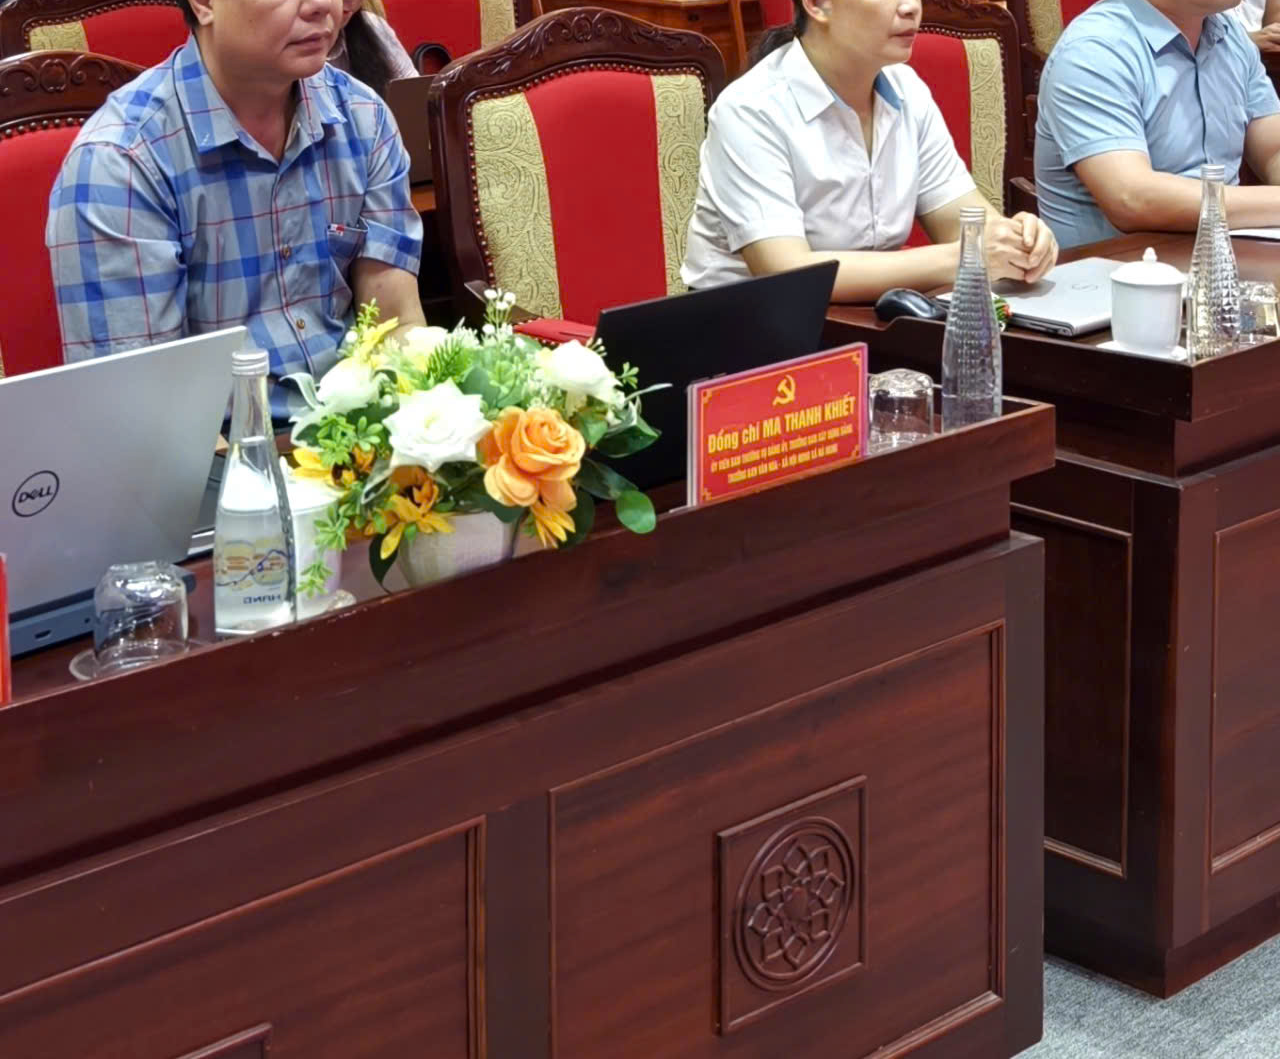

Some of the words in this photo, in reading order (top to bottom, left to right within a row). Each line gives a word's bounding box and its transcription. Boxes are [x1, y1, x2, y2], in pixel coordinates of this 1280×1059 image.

[763, 418, 781, 438] MA
[785, 405, 822, 432] THANH
[824, 392, 856, 421] KHIẾT
